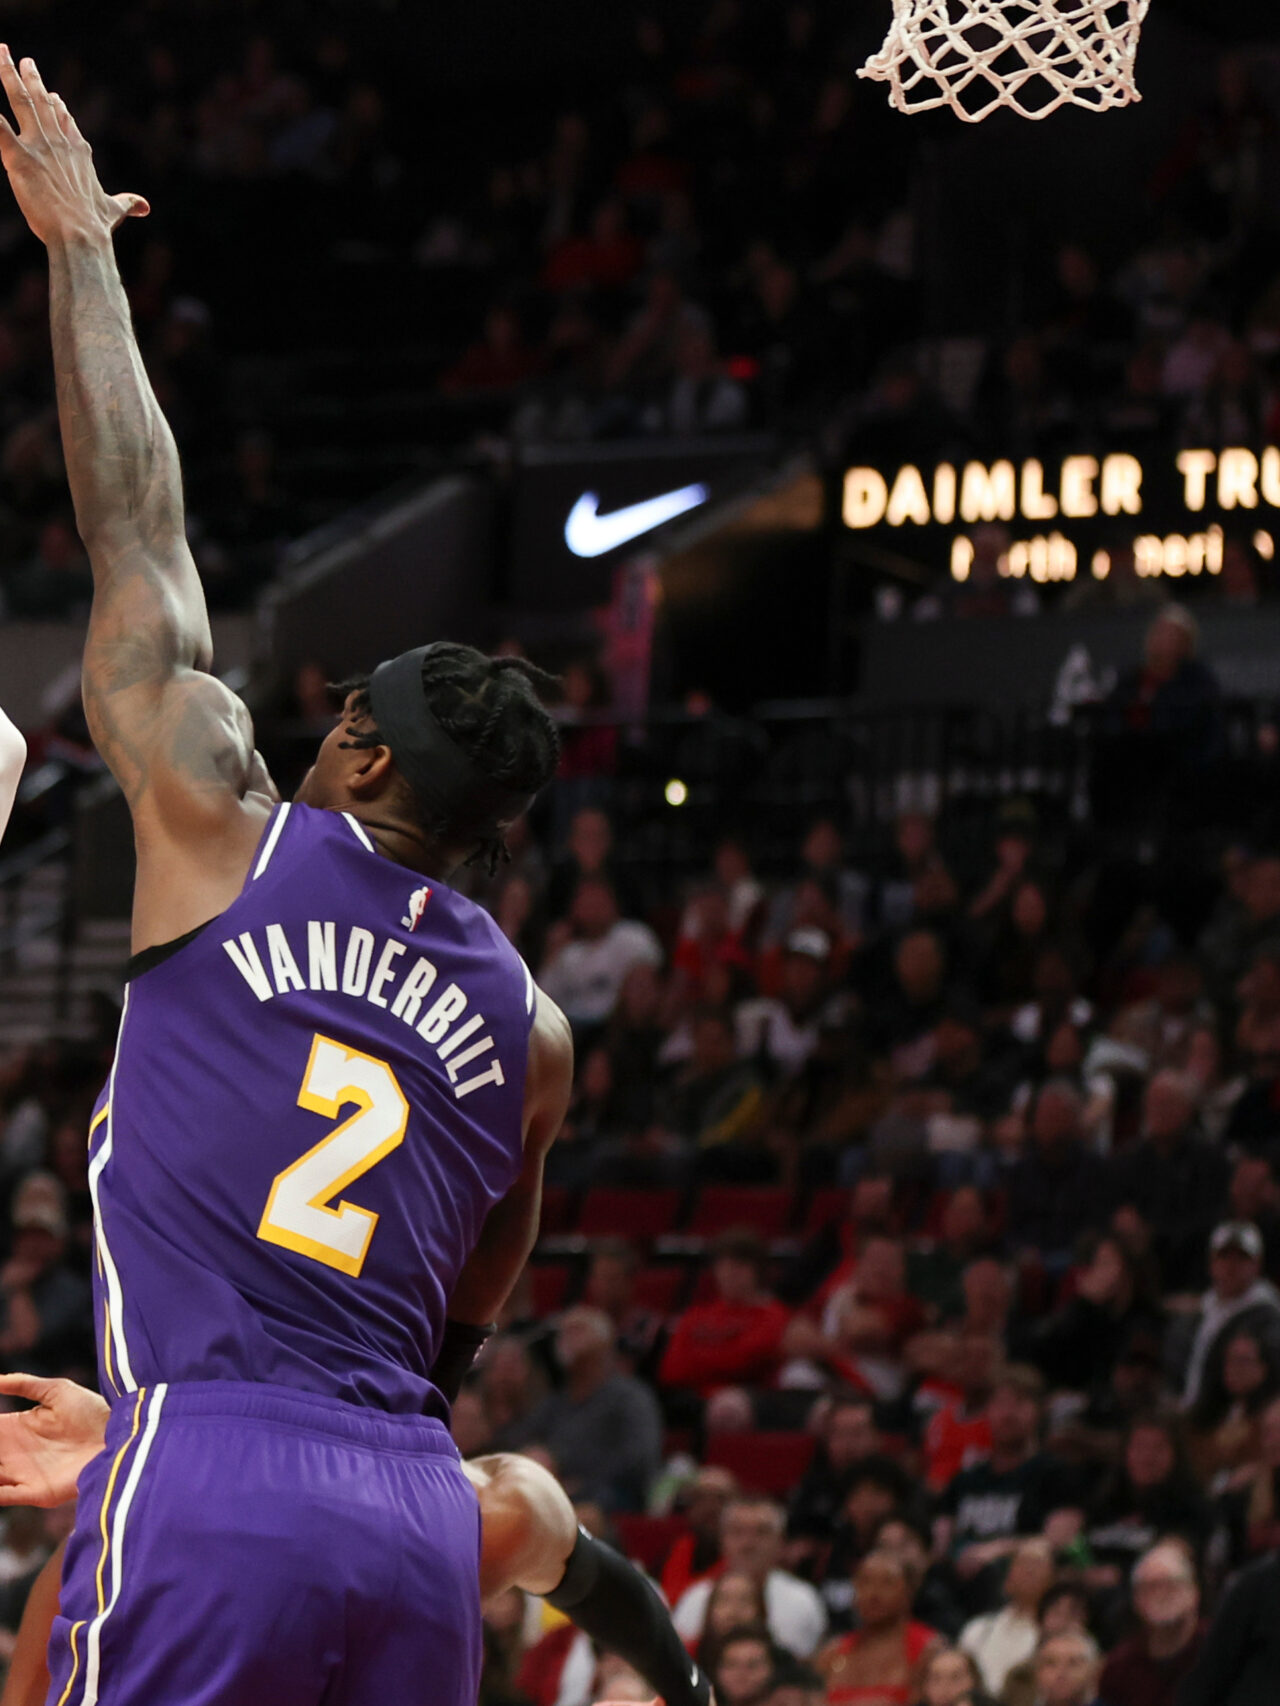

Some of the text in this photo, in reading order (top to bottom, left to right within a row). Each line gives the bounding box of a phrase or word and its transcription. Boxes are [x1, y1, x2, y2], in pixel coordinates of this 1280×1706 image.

[842, 452, 1142, 529] DAIMLER
[222, 921, 505, 1098] VANDERBILT
[257, 1033, 410, 1278] 2
